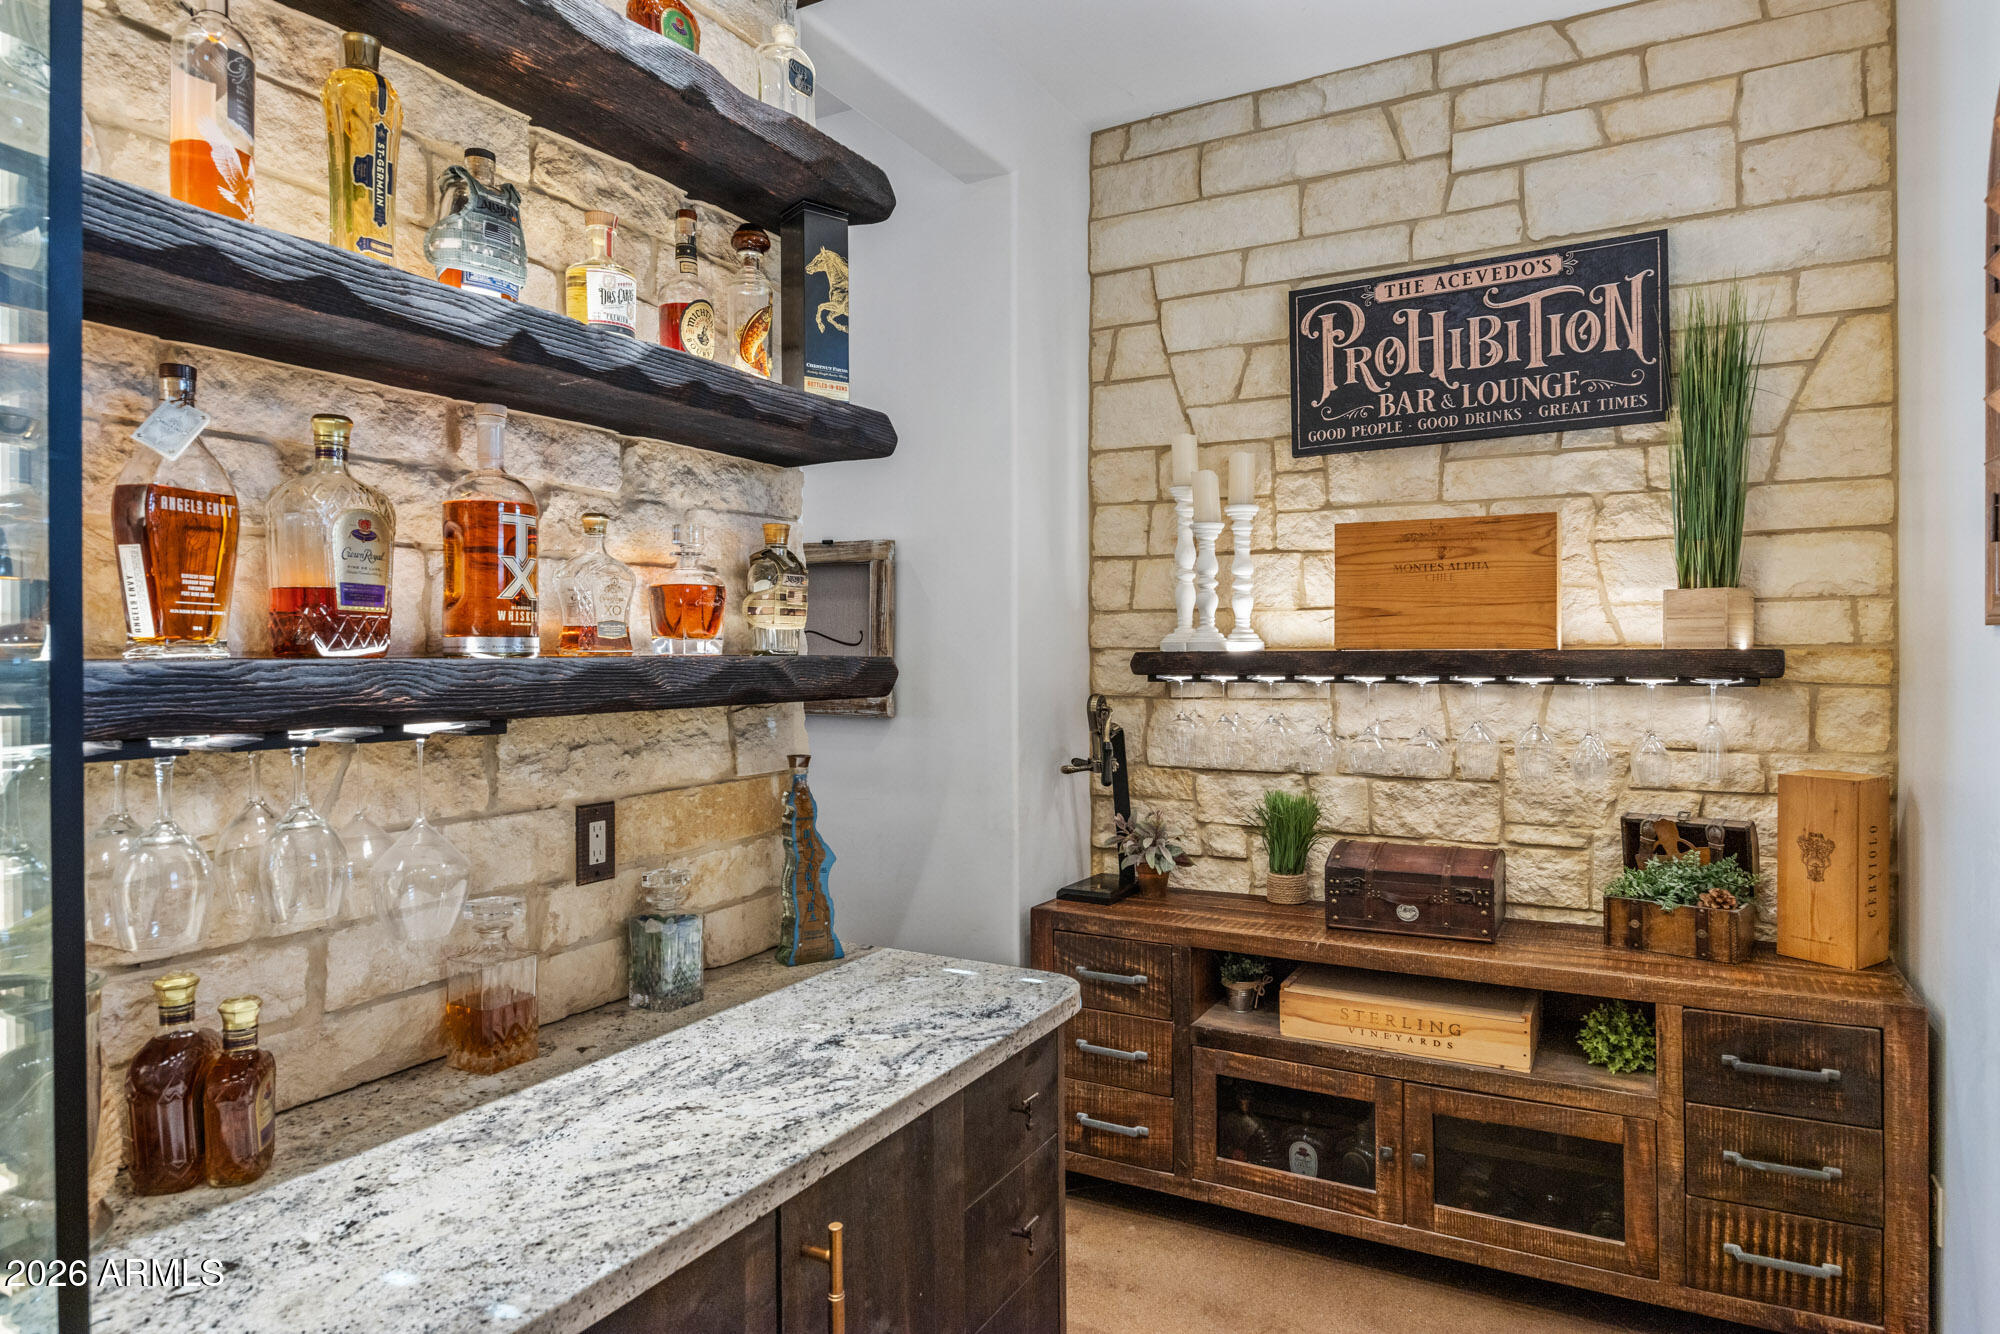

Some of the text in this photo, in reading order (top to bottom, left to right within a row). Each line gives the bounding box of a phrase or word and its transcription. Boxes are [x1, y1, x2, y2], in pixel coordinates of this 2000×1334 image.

[376, 142, 386, 207] ST-GERMAIN
[1384, 258, 1553, 298] THE ACEVEDO'S
[1378, 370, 1582, 418] BAR & LOUNGE
[1308, 393, 1649, 443] GOOD PEOPLE GOOD DRINKS GREAT TIMES
[206, 502, 232, 518] ENVY
[1393, 561, 1489, 573] MONTES ALPHA
[1867, 825, 1878, 918] CERVIOLO
[1340, 1007, 1461, 1037] STERLING
[1348, 1027, 1453, 1049] VINEYARDS
